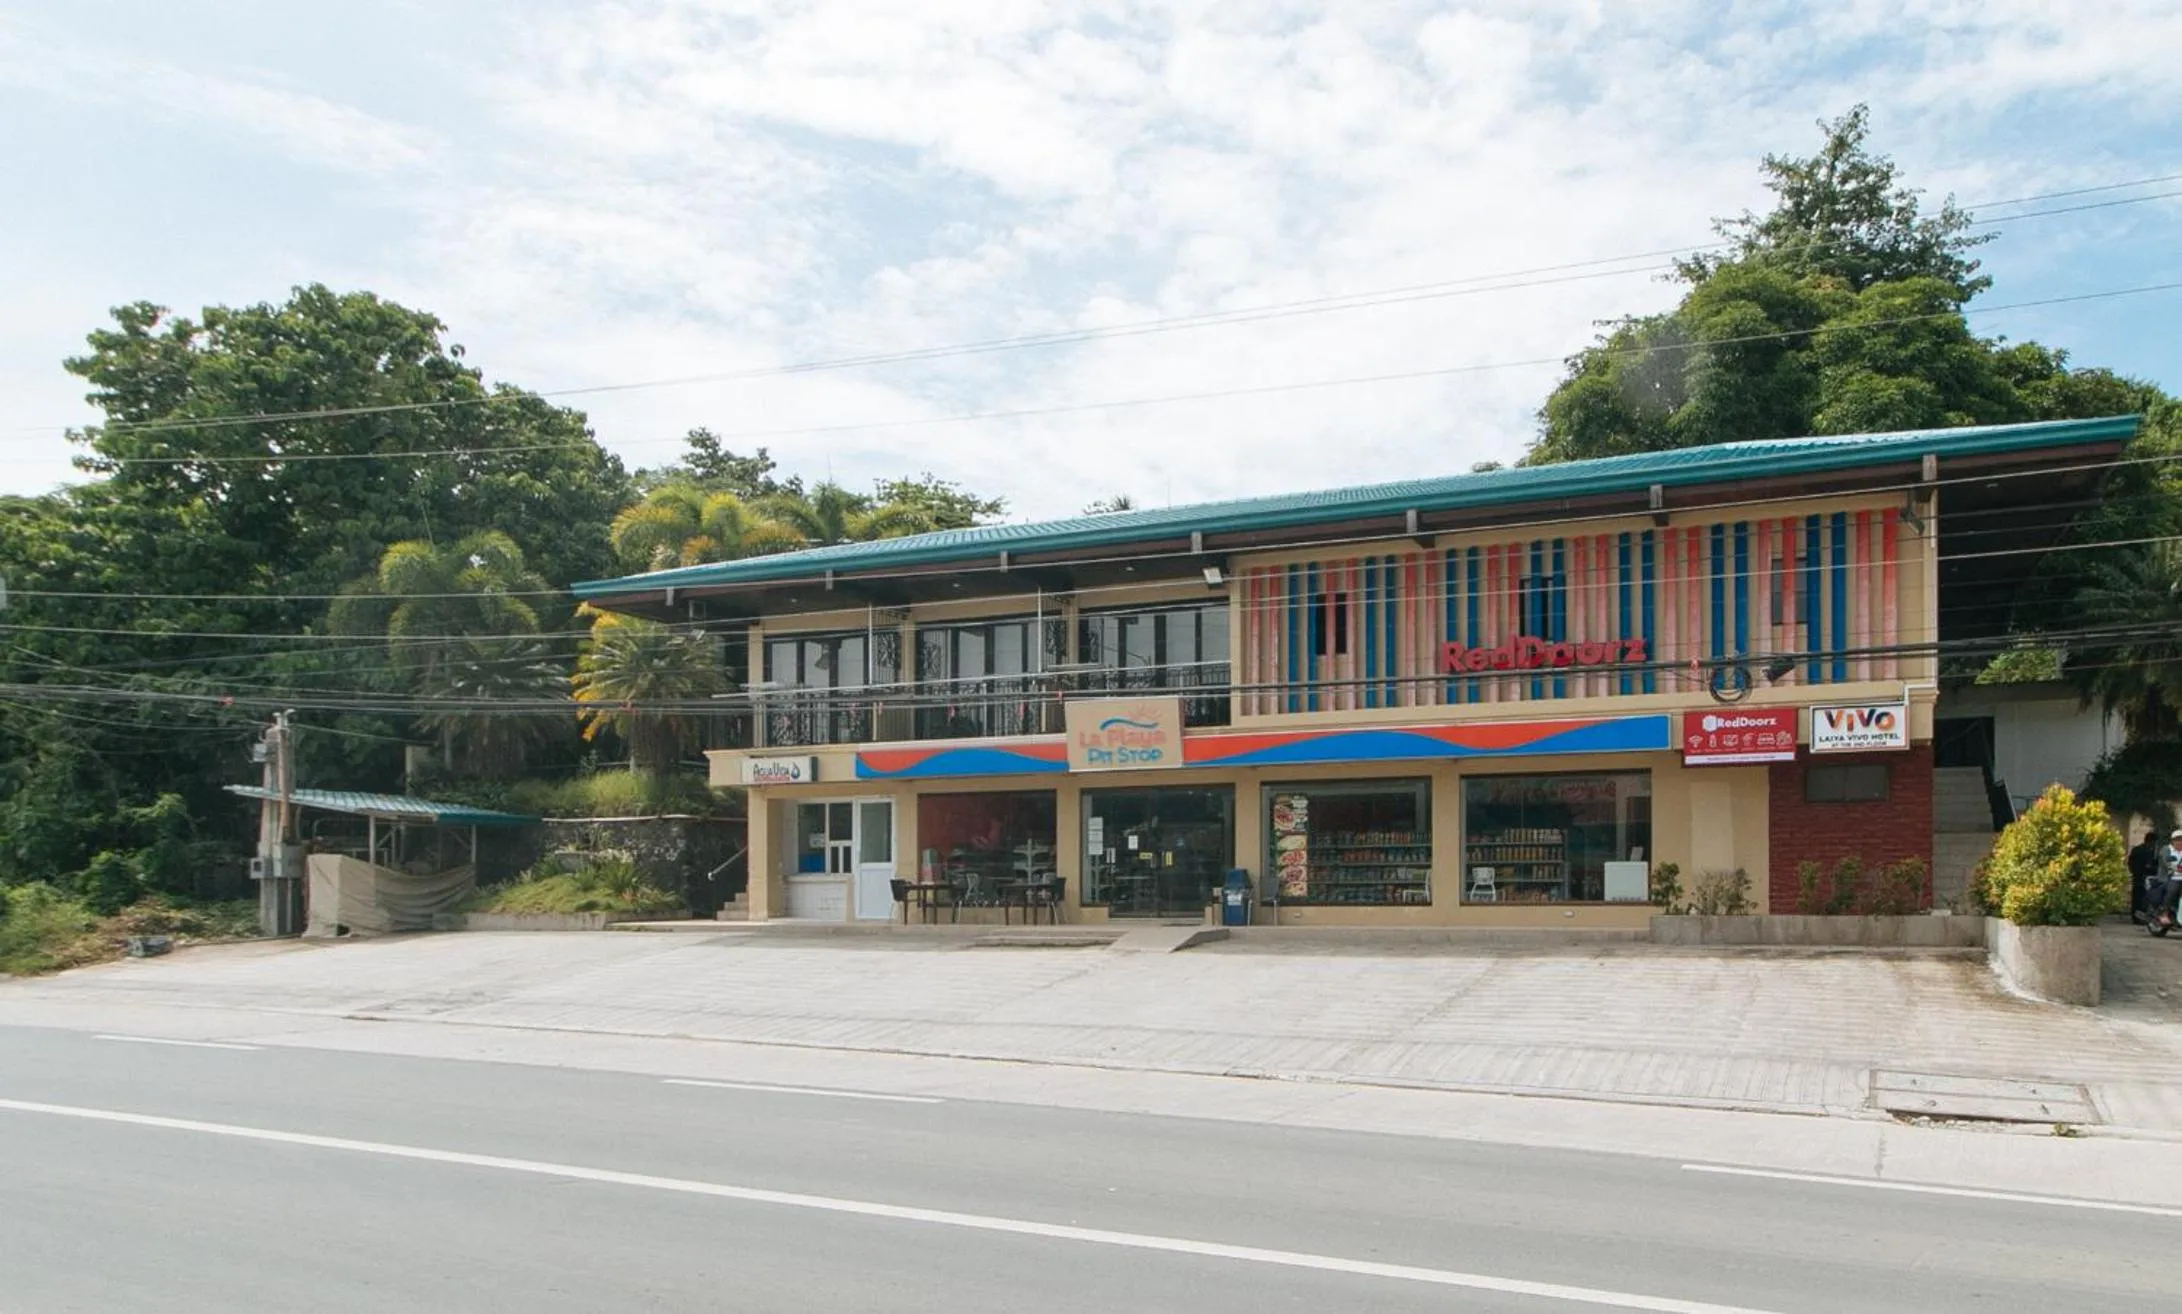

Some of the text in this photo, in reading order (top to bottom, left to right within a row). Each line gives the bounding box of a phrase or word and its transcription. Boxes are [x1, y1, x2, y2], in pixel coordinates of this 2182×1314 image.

[1440, 634, 1646, 673] RedDoorz
[1717, 717, 1777, 728] RedDoorz
[1107, 728, 1167, 748] Playa
[1819, 732, 1900, 743] LAIYA VIVO HOTEL
